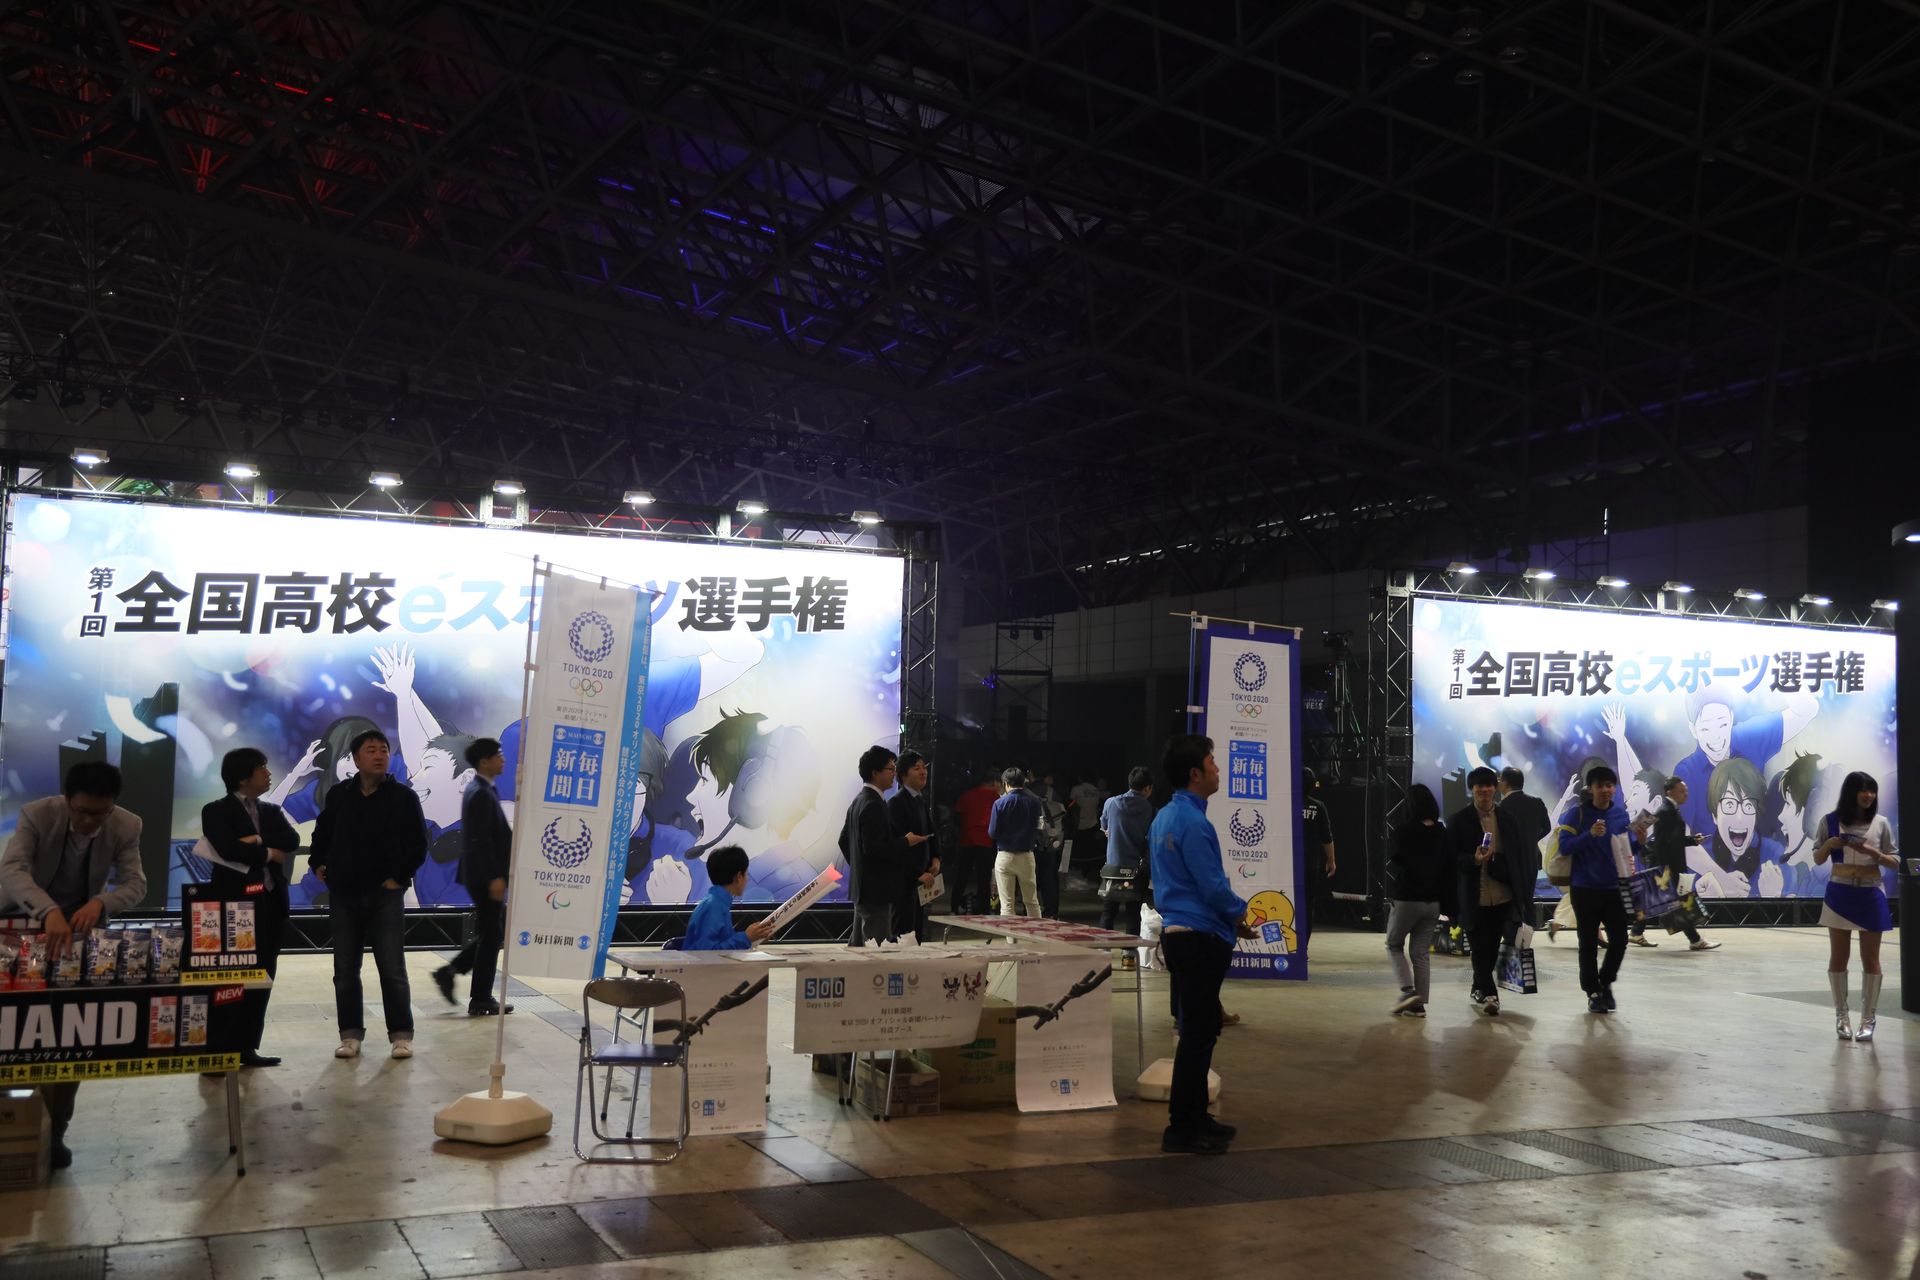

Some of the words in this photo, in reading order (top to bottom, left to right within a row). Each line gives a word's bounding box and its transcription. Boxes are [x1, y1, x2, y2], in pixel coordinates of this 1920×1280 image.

[80, 567, 116, 638] 第1回
[563, 662, 590, 676] TOKYO
[591, 667, 614, 680] 2020
[1448, 648, 1466, 701] 第1回
[1466, 650, 1866, 698] 全国高校eスポーツ選手権
[1231, 693, 1252, 702] TOKYO
[1252, 695, 1269, 704] 2020
[1228, 849, 1250, 858] TOKYO
[1250, 851, 1268, 859] 2020
[534, 870, 566, 882] TOKYO
[567, 873, 591, 885] 2020
[244, 883, 265, 892] NEW
[534, 933, 574, 947] 毎日新聞
[190, 955, 217, 967] ONE
[219, 953, 258, 966] HAND
[216, 987, 243, 1001] NEW
[806, 980, 843, 997] 500
[806, 1002, 821, 1010] Days
[824, 1000, 831, 1008] to
[30, 1065, 57, 1077] 無料
[74, 1063, 100, 1074] 無料
[116, 1061, 142, 1072] 無料
[158, 1058, 183, 1069] 無料
[198, 1056, 224, 1068] 無料
